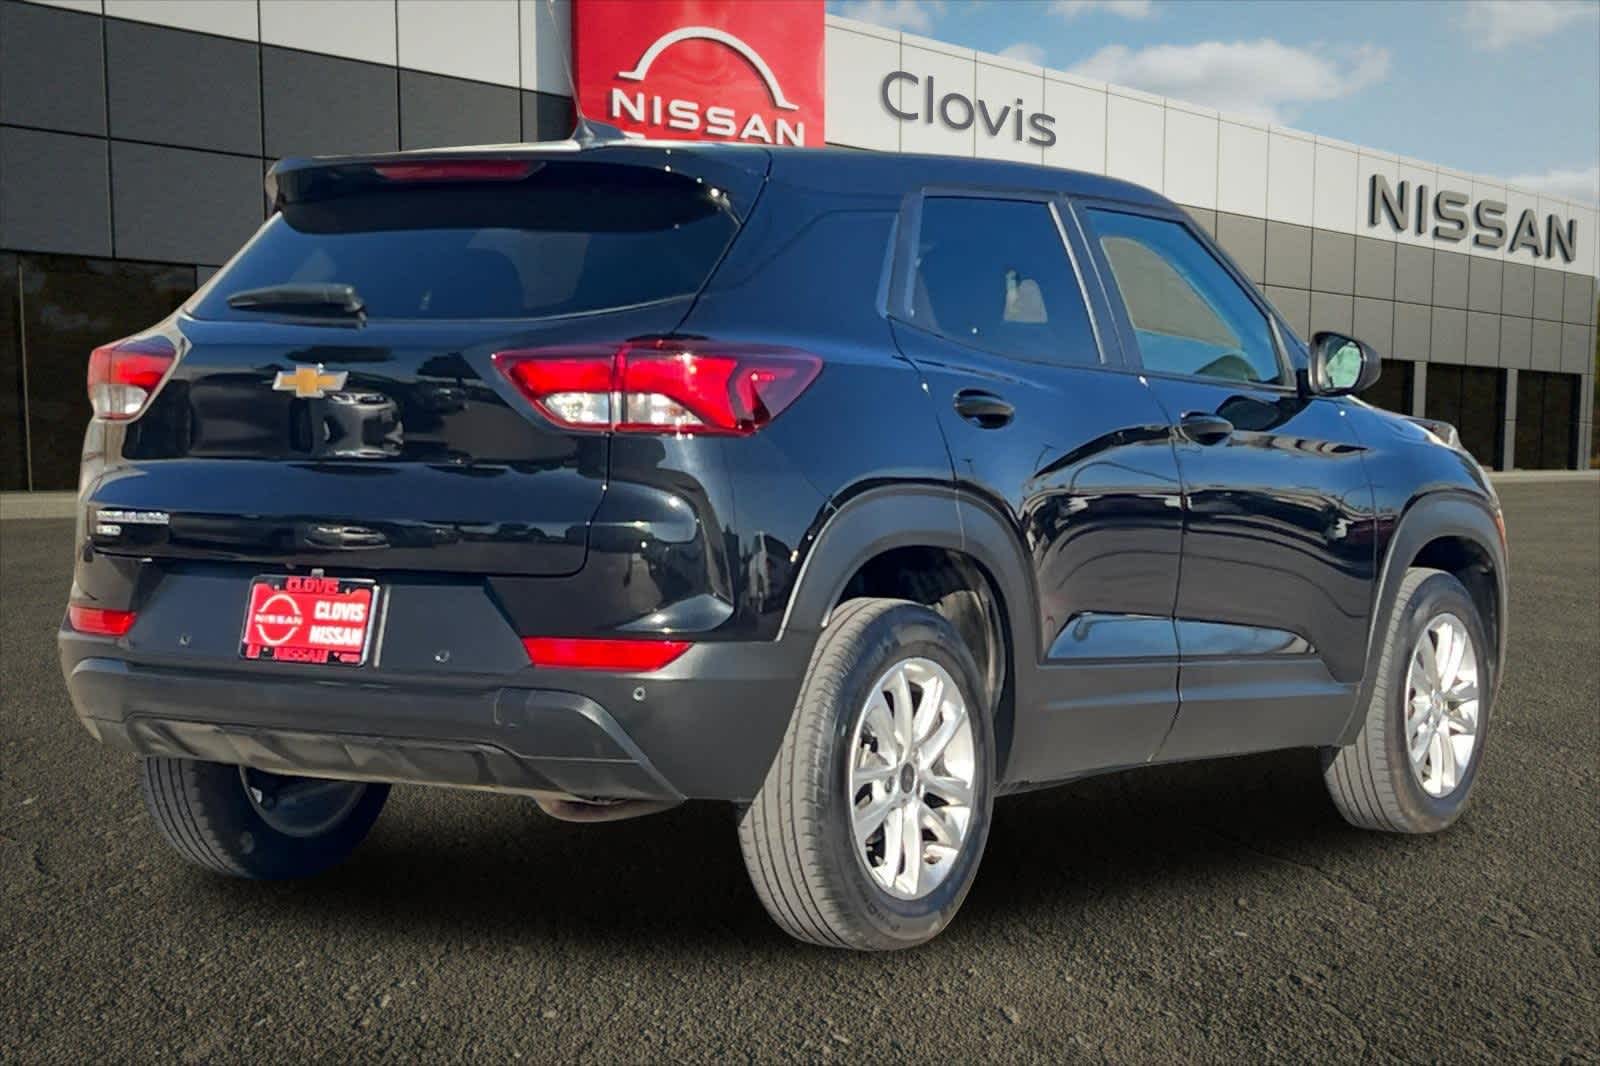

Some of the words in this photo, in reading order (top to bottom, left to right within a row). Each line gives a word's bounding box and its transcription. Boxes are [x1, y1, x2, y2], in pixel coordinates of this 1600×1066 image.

[611, 87, 805, 147] NISSAN
[881, 70, 1057, 147] Clovis
[1368, 173, 1577, 263] NISSAN
[287, 577, 338, 593] CLOVIS
[255, 614, 303, 624] NISSAN
[314, 601, 365, 621] CLOVIS
[309, 626, 362, 645] NISSAN
